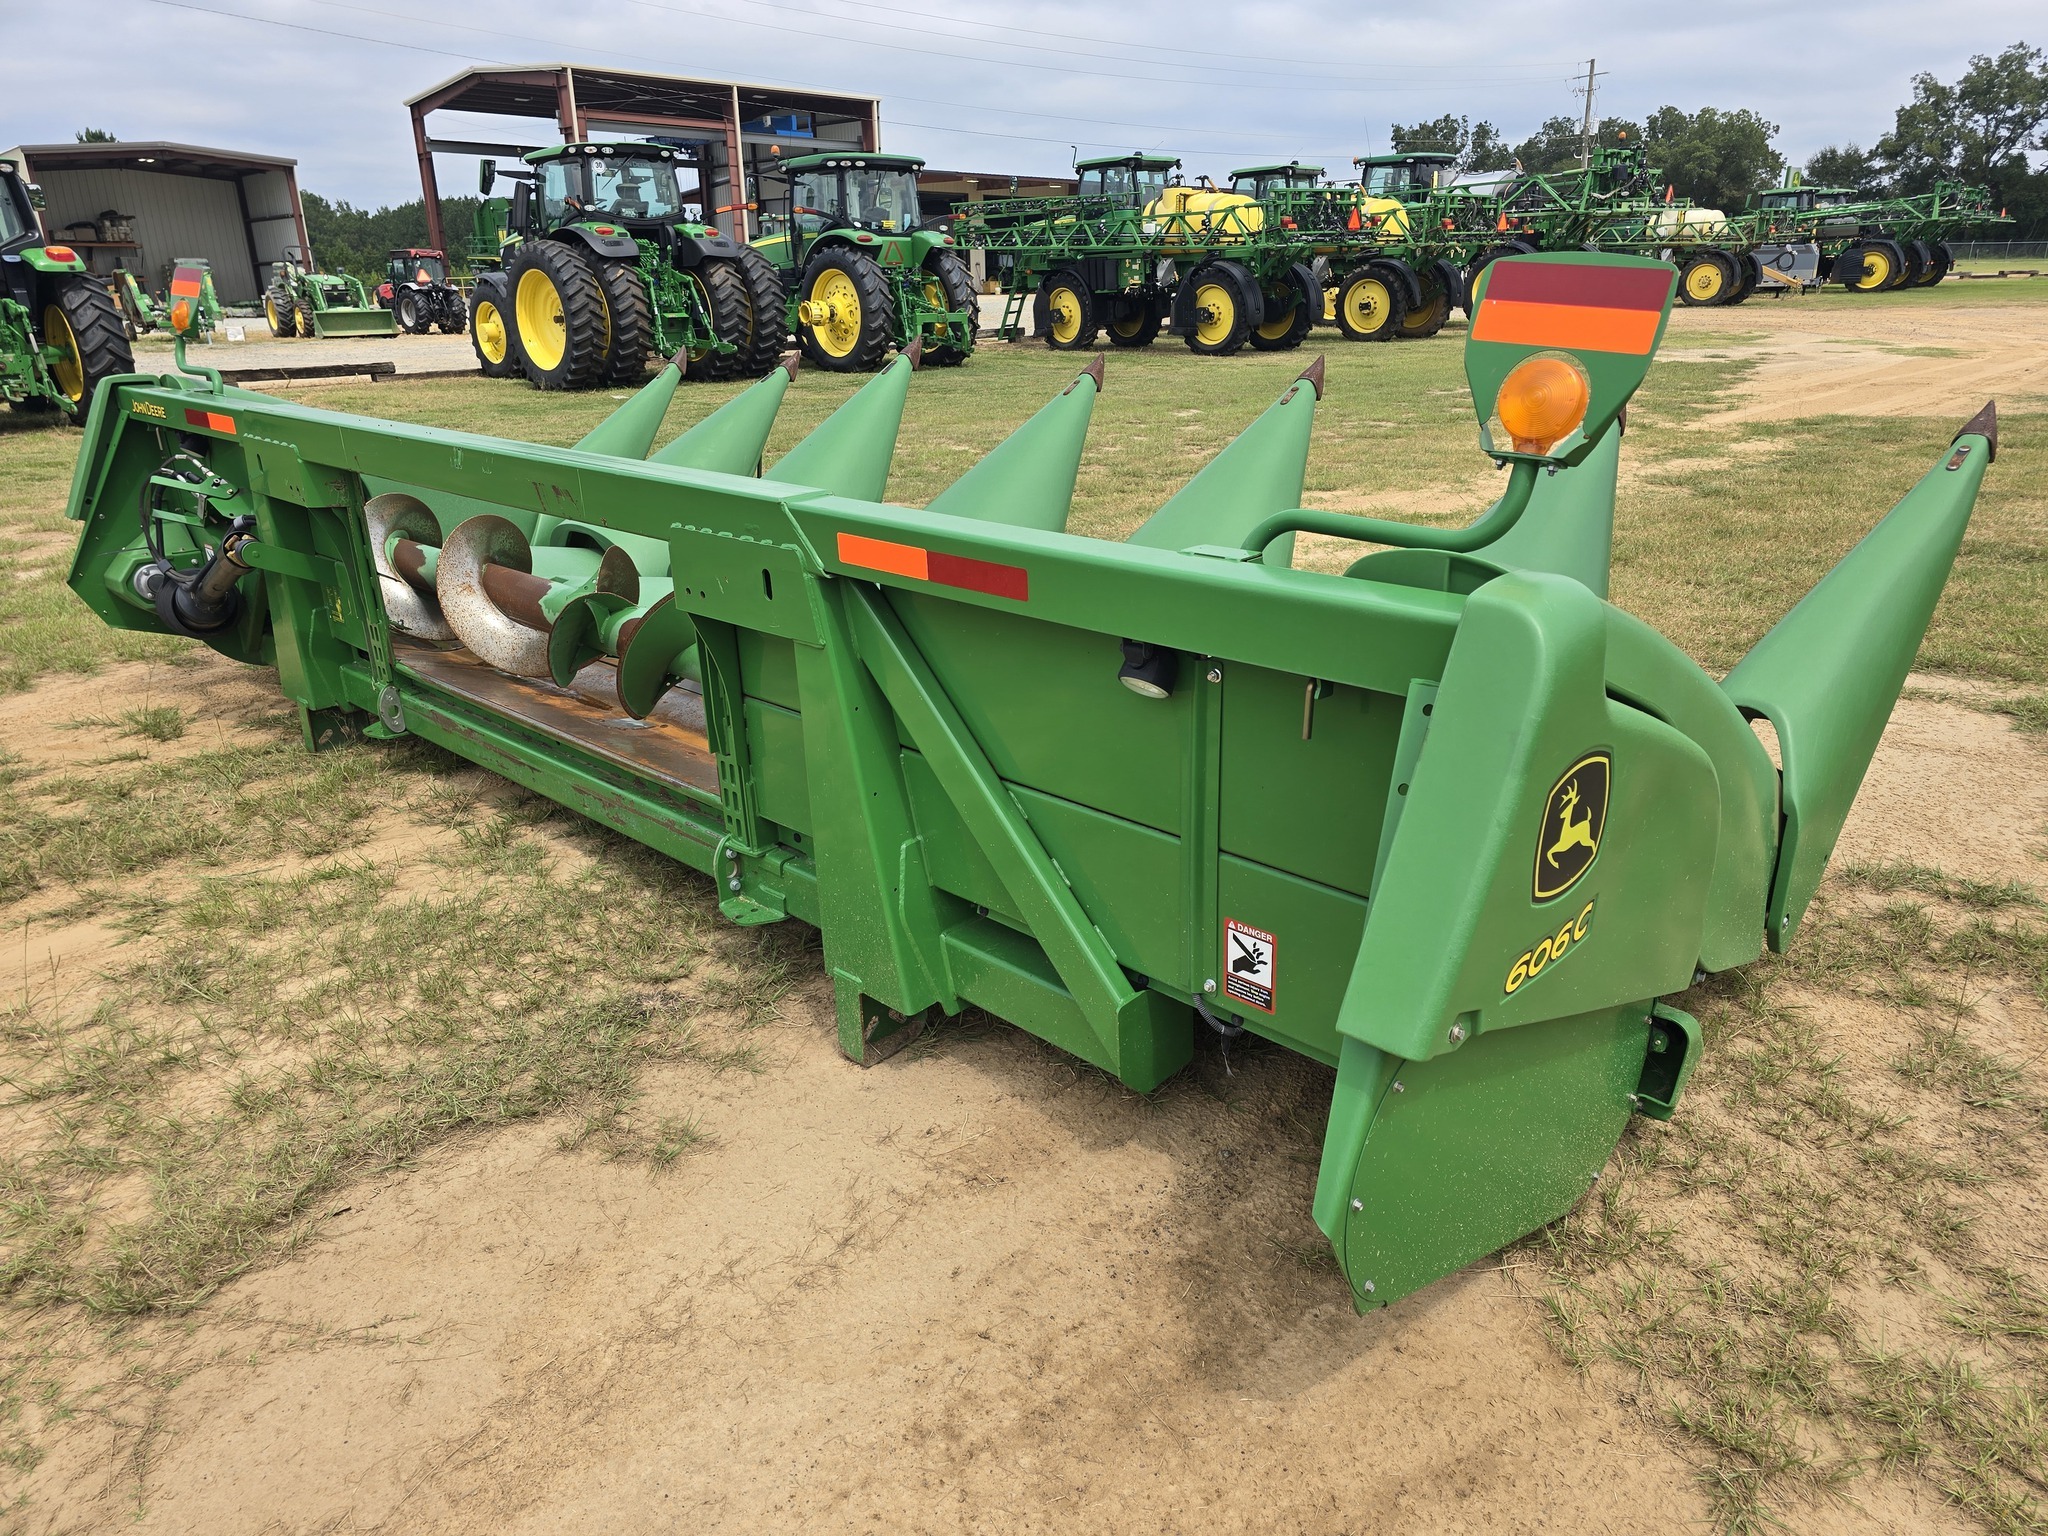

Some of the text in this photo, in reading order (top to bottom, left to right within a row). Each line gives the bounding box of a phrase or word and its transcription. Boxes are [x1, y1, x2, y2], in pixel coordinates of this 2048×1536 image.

[132, 399, 167, 419] JOHN DEERE
[1237, 923, 1273, 943] DANGER
[1503, 899, 1595, 996] 606C
